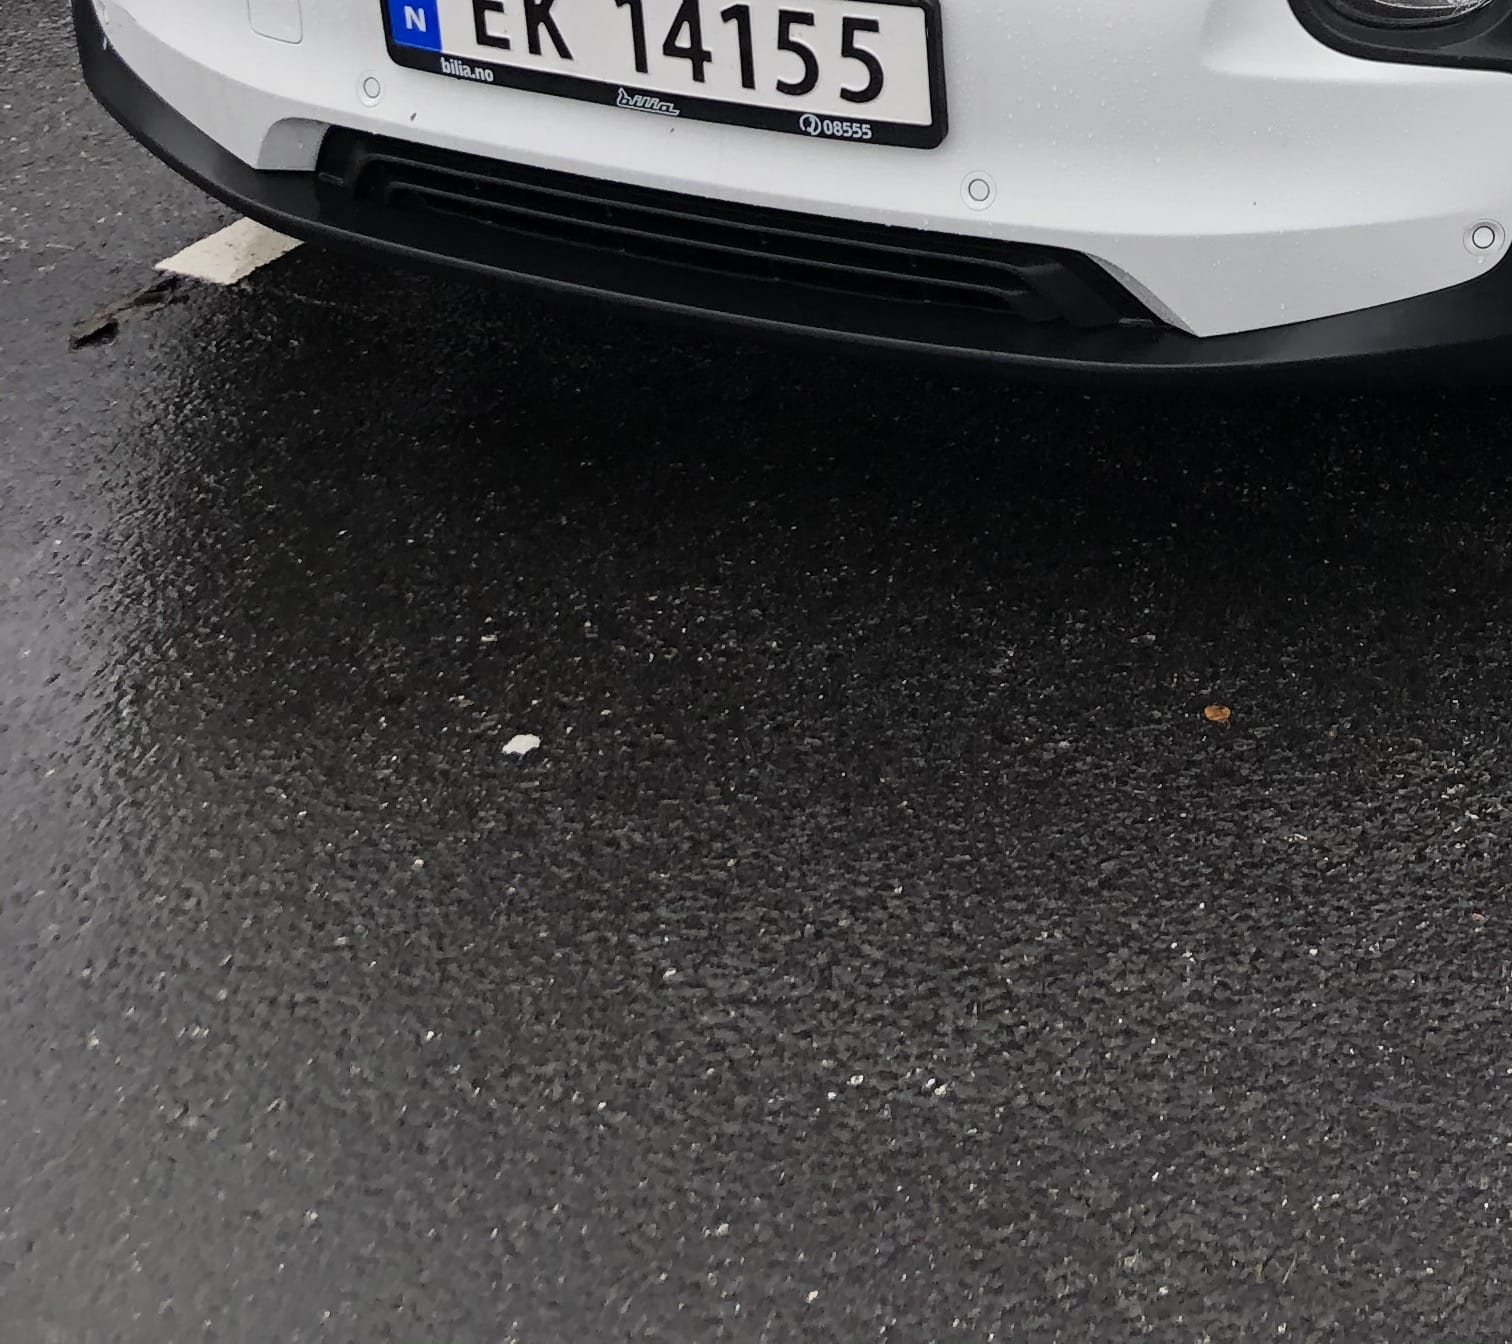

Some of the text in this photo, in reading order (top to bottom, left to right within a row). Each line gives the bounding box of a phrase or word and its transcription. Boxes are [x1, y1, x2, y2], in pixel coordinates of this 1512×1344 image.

[405, 5, 427, 33] N
[440, 57, 494, 82] bilia.no
[823, 119, 872, 139] 08555
